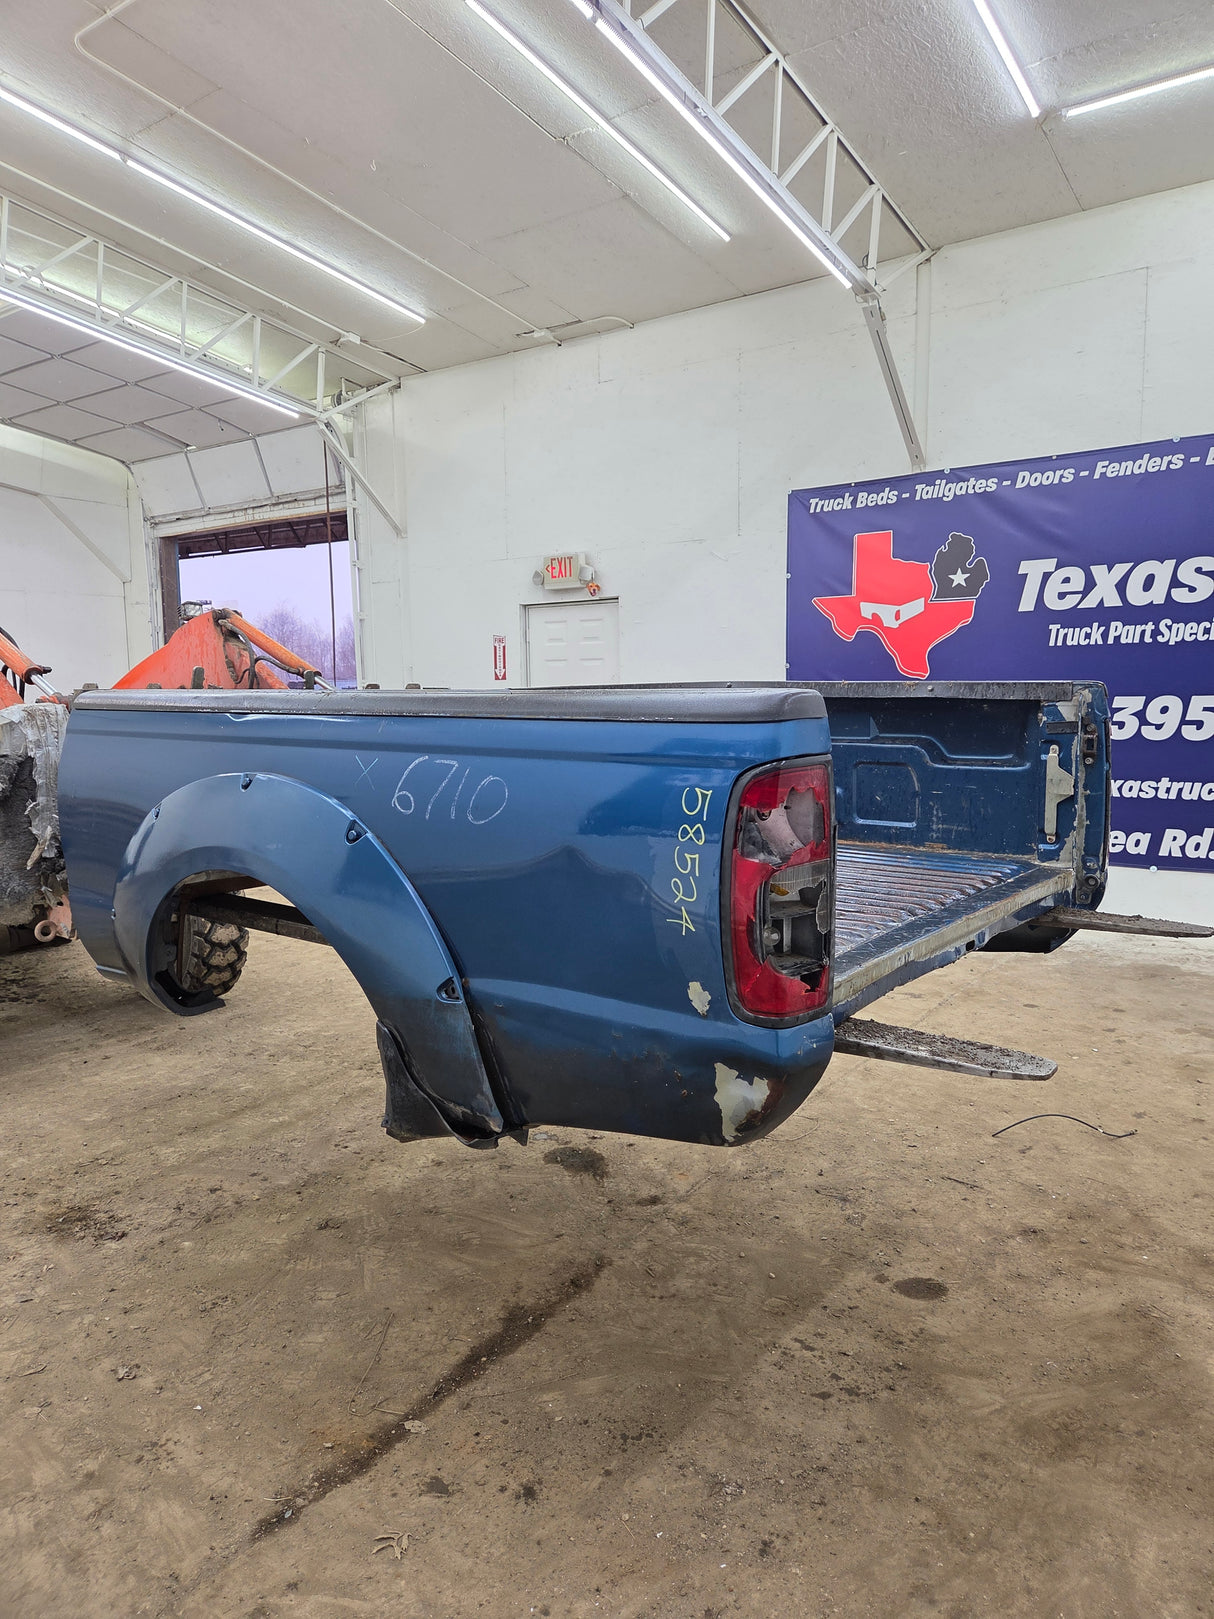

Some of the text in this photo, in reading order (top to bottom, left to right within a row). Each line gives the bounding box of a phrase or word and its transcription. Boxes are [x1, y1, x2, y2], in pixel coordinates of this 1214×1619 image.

[808, 492, 854, 514] Truck
[855, 487, 899, 509] Beds
[914, 476, 999, 502] Tailgates
[1015, 467, 1076, 489] Doors
[1093, 453, 1185, 480] Fenders
[550, 556, 573, 579] EXIT
[1017, 555, 1214, 613] Texas
[1048, 622, 1106, 647] Truck
[1107, 620, 1155, 645] Part
[1110, 694, 1214, 742] 395
[391, 755, 509, 825] 6710
[666, 787, 713, 936] 58524
